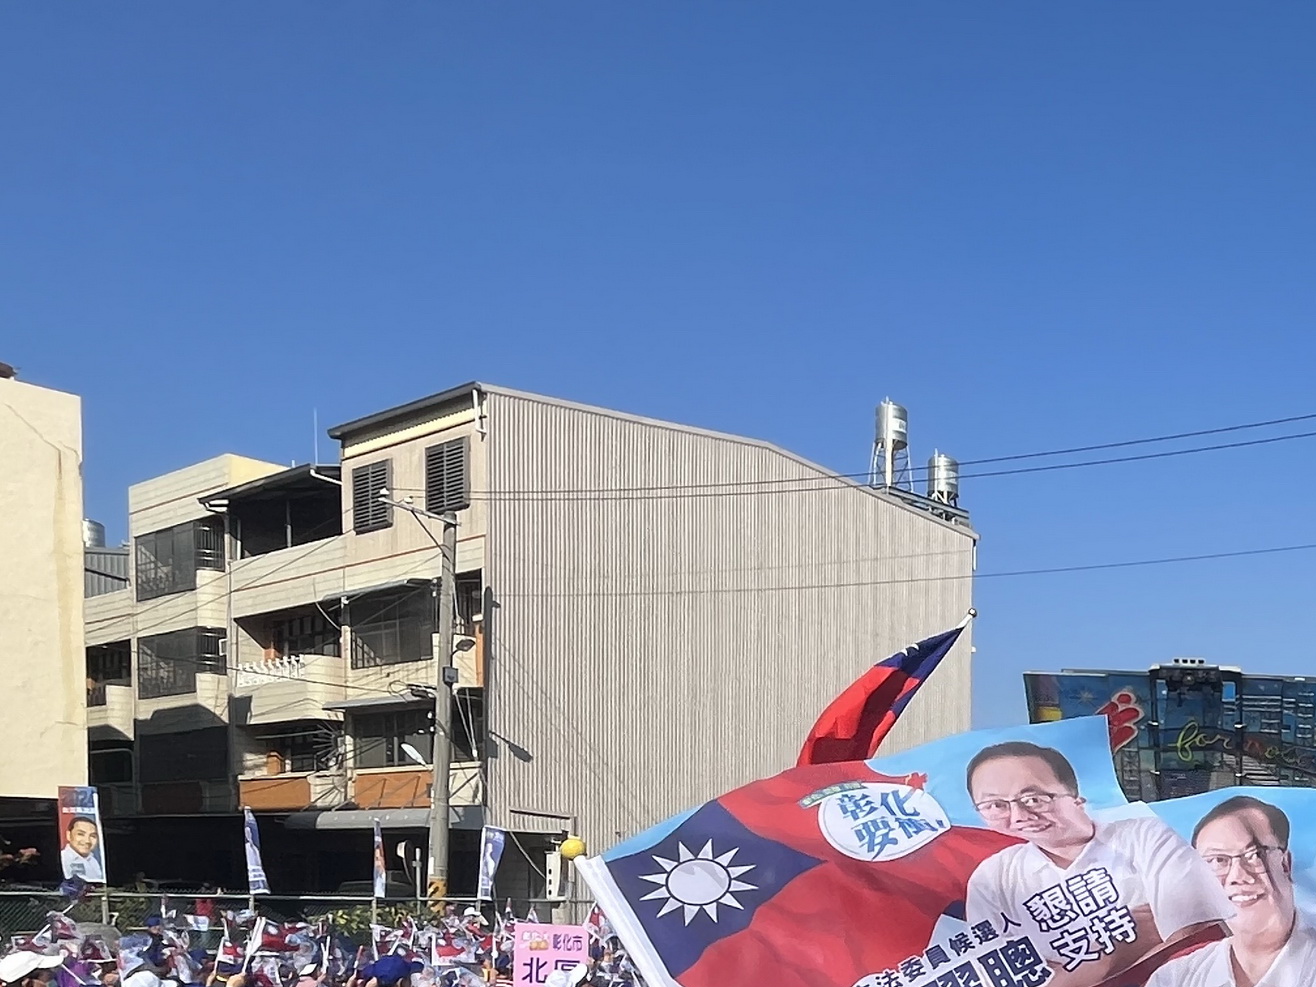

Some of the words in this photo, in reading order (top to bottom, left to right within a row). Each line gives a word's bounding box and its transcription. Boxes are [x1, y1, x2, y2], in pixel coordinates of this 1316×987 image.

[838, 790, 920, 821] 彰化
[1024, 867, 1120, 934] 懇請
[1049, 904, 1137, 972] 支持
